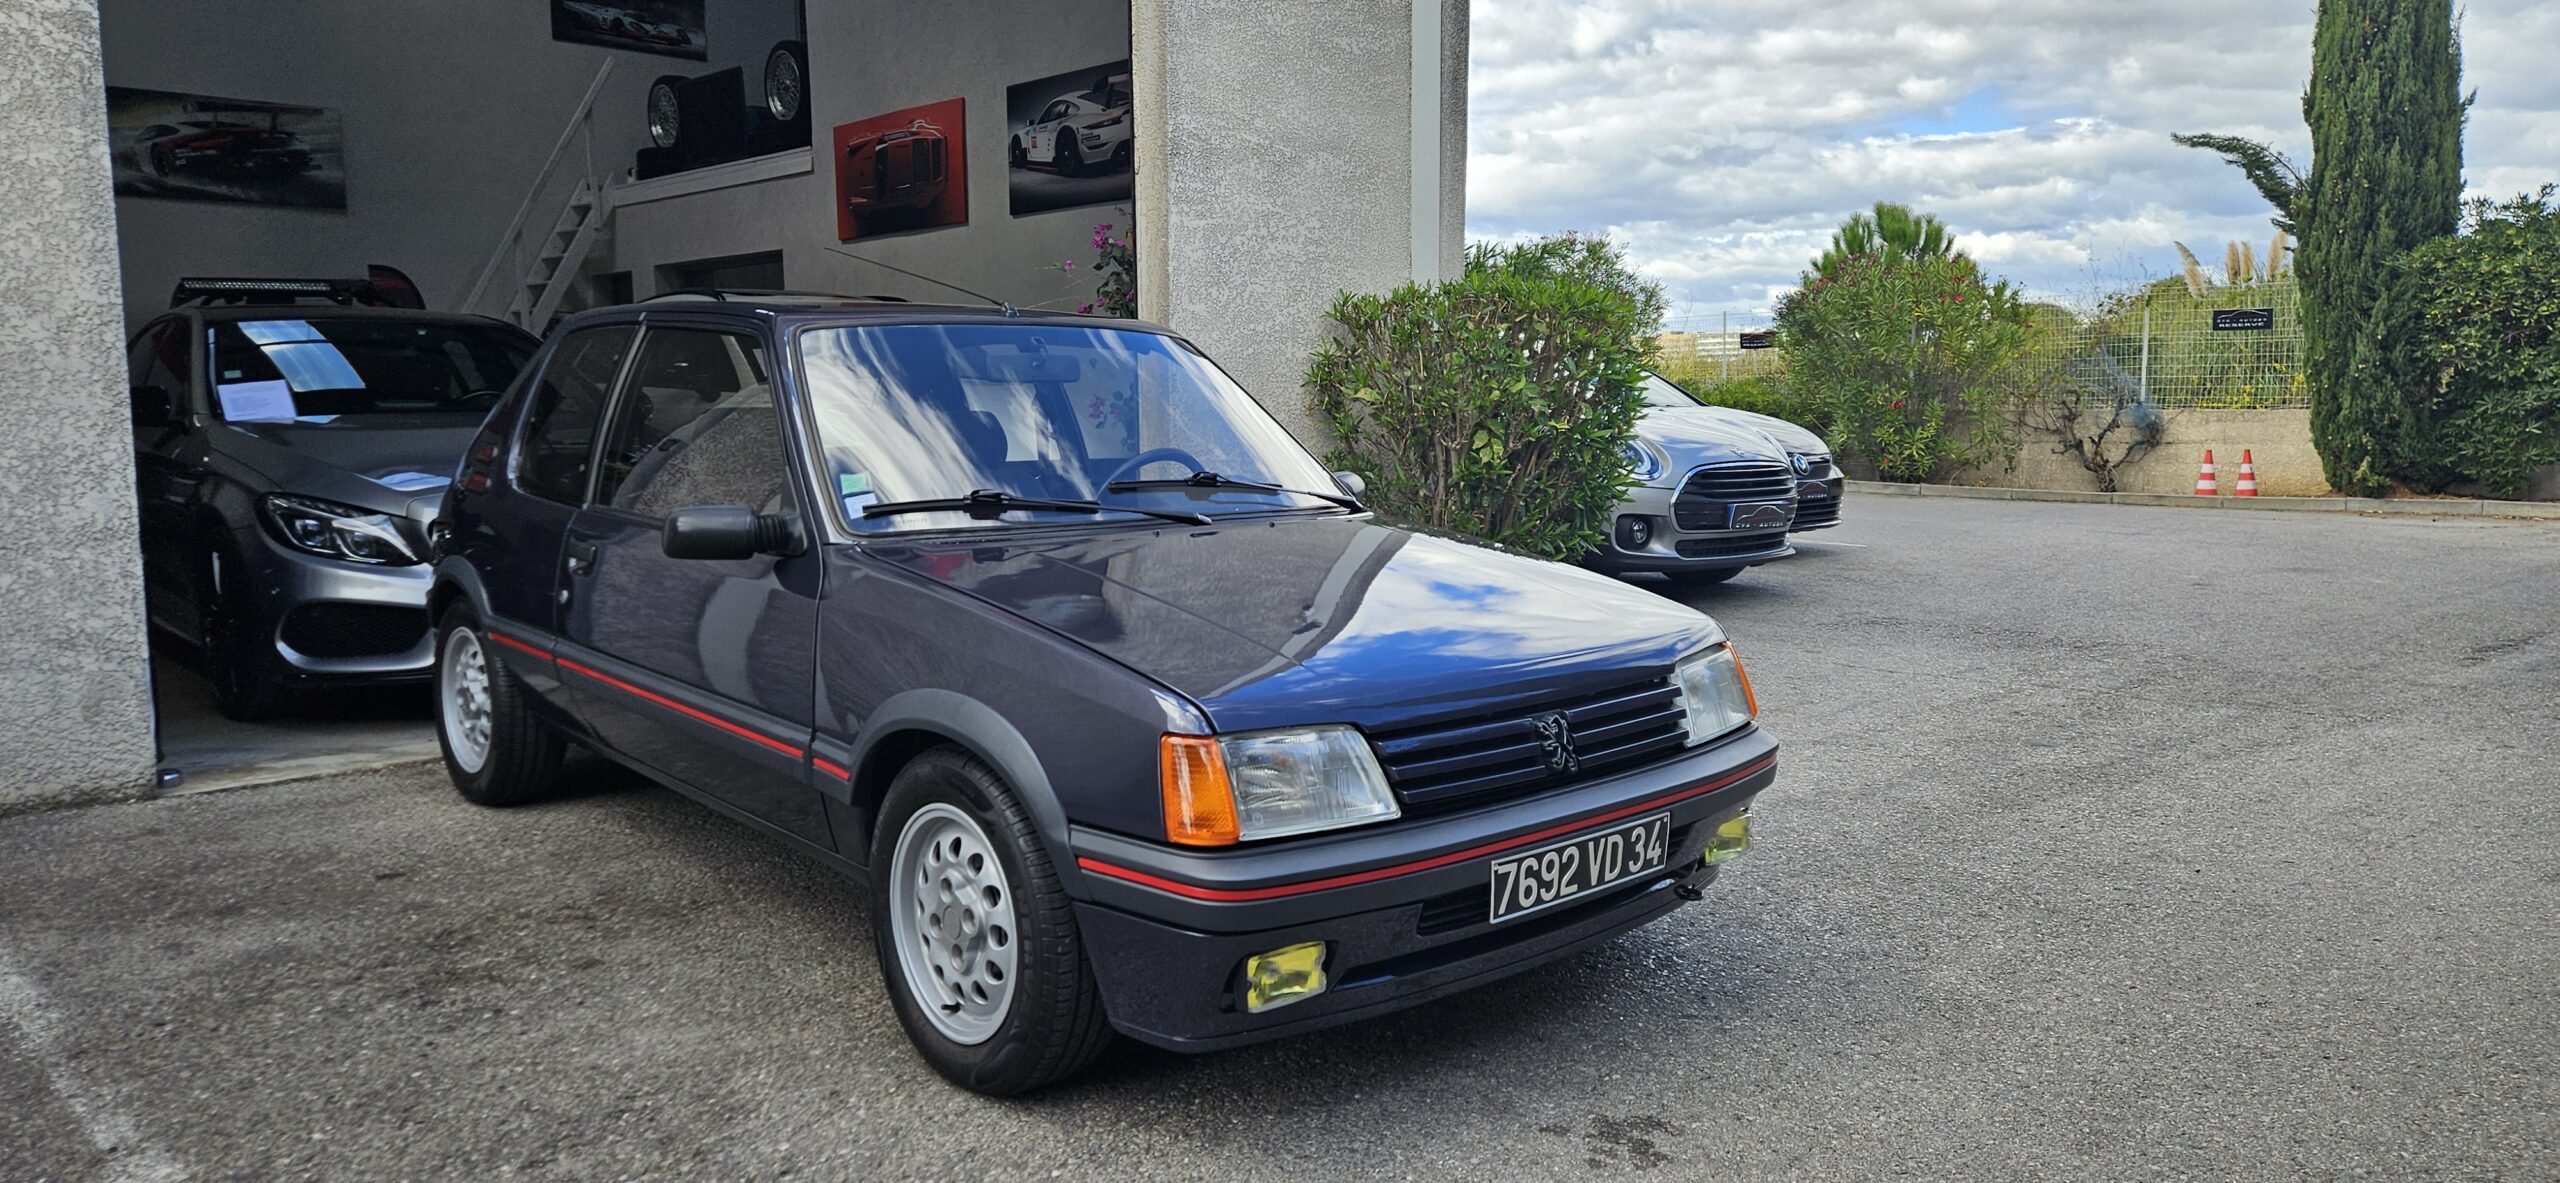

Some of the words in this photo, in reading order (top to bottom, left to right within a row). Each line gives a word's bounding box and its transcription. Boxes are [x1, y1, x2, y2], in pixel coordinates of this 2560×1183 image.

[1498, 845, 1580, 916] 7692
[1588, 834, 1624, 887] VD
[1628, 820, 1662, 874] 34
